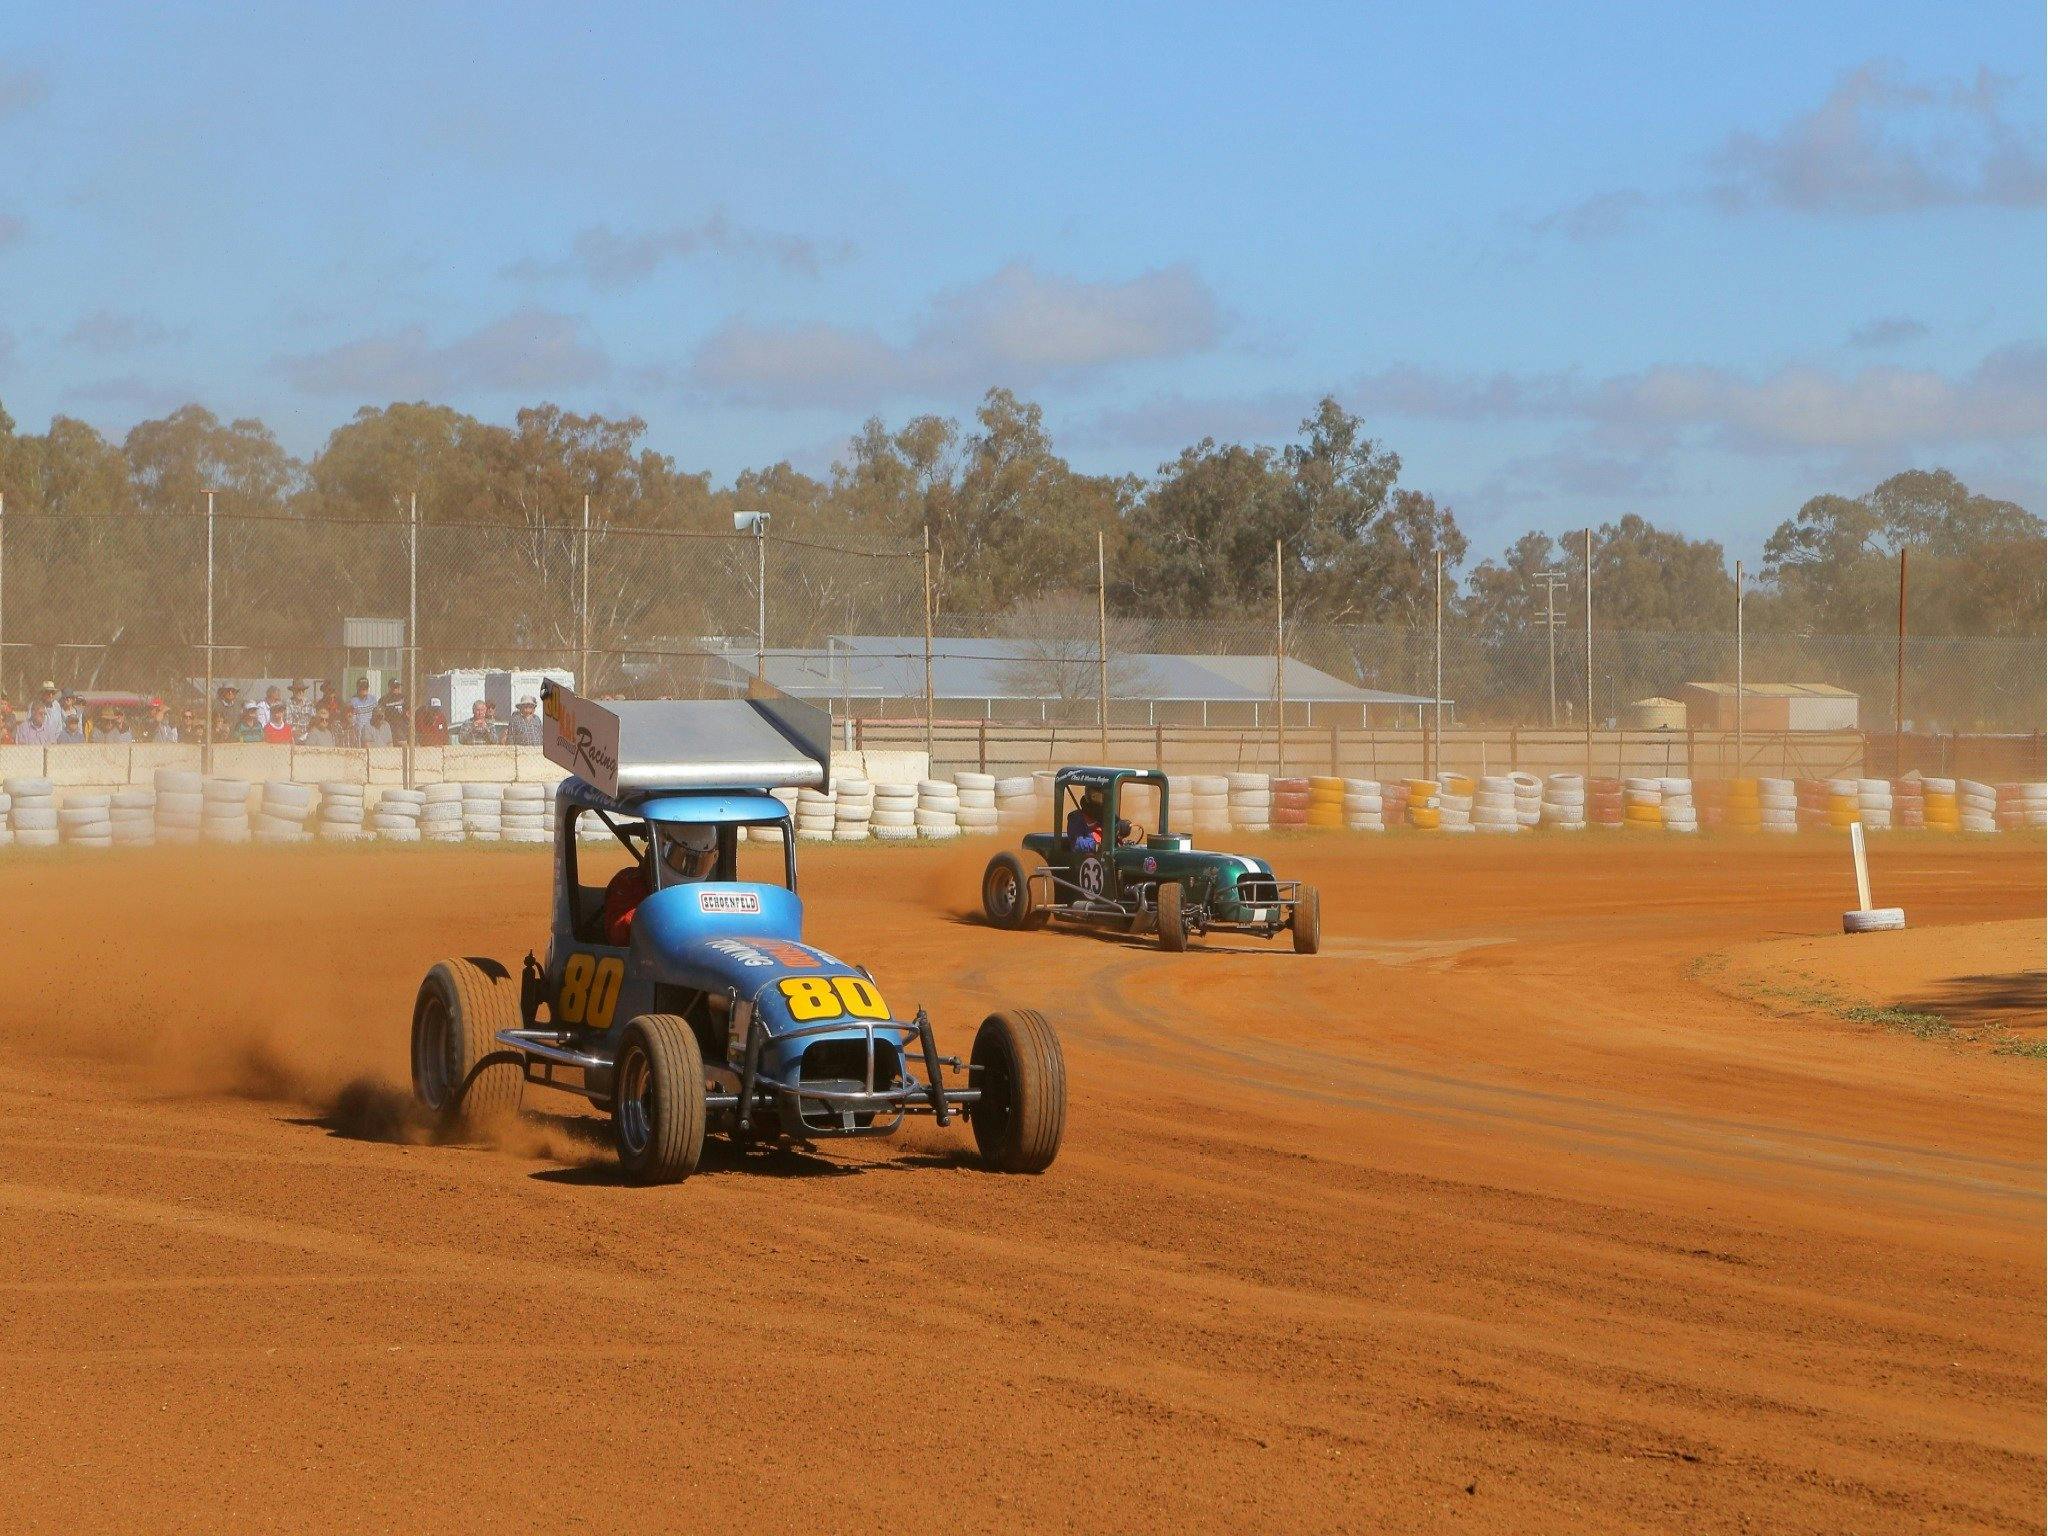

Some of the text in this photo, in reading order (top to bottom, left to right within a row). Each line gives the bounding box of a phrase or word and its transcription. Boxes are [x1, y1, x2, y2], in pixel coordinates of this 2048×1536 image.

[573, 726, 619, 780] Racing
[1081, 862, 1102, 895] 63
[703, 896, 756, 909] SCHOENFELD
[560, 953, 624, 1029] 80
[779, 976, 891, 1020] 80
